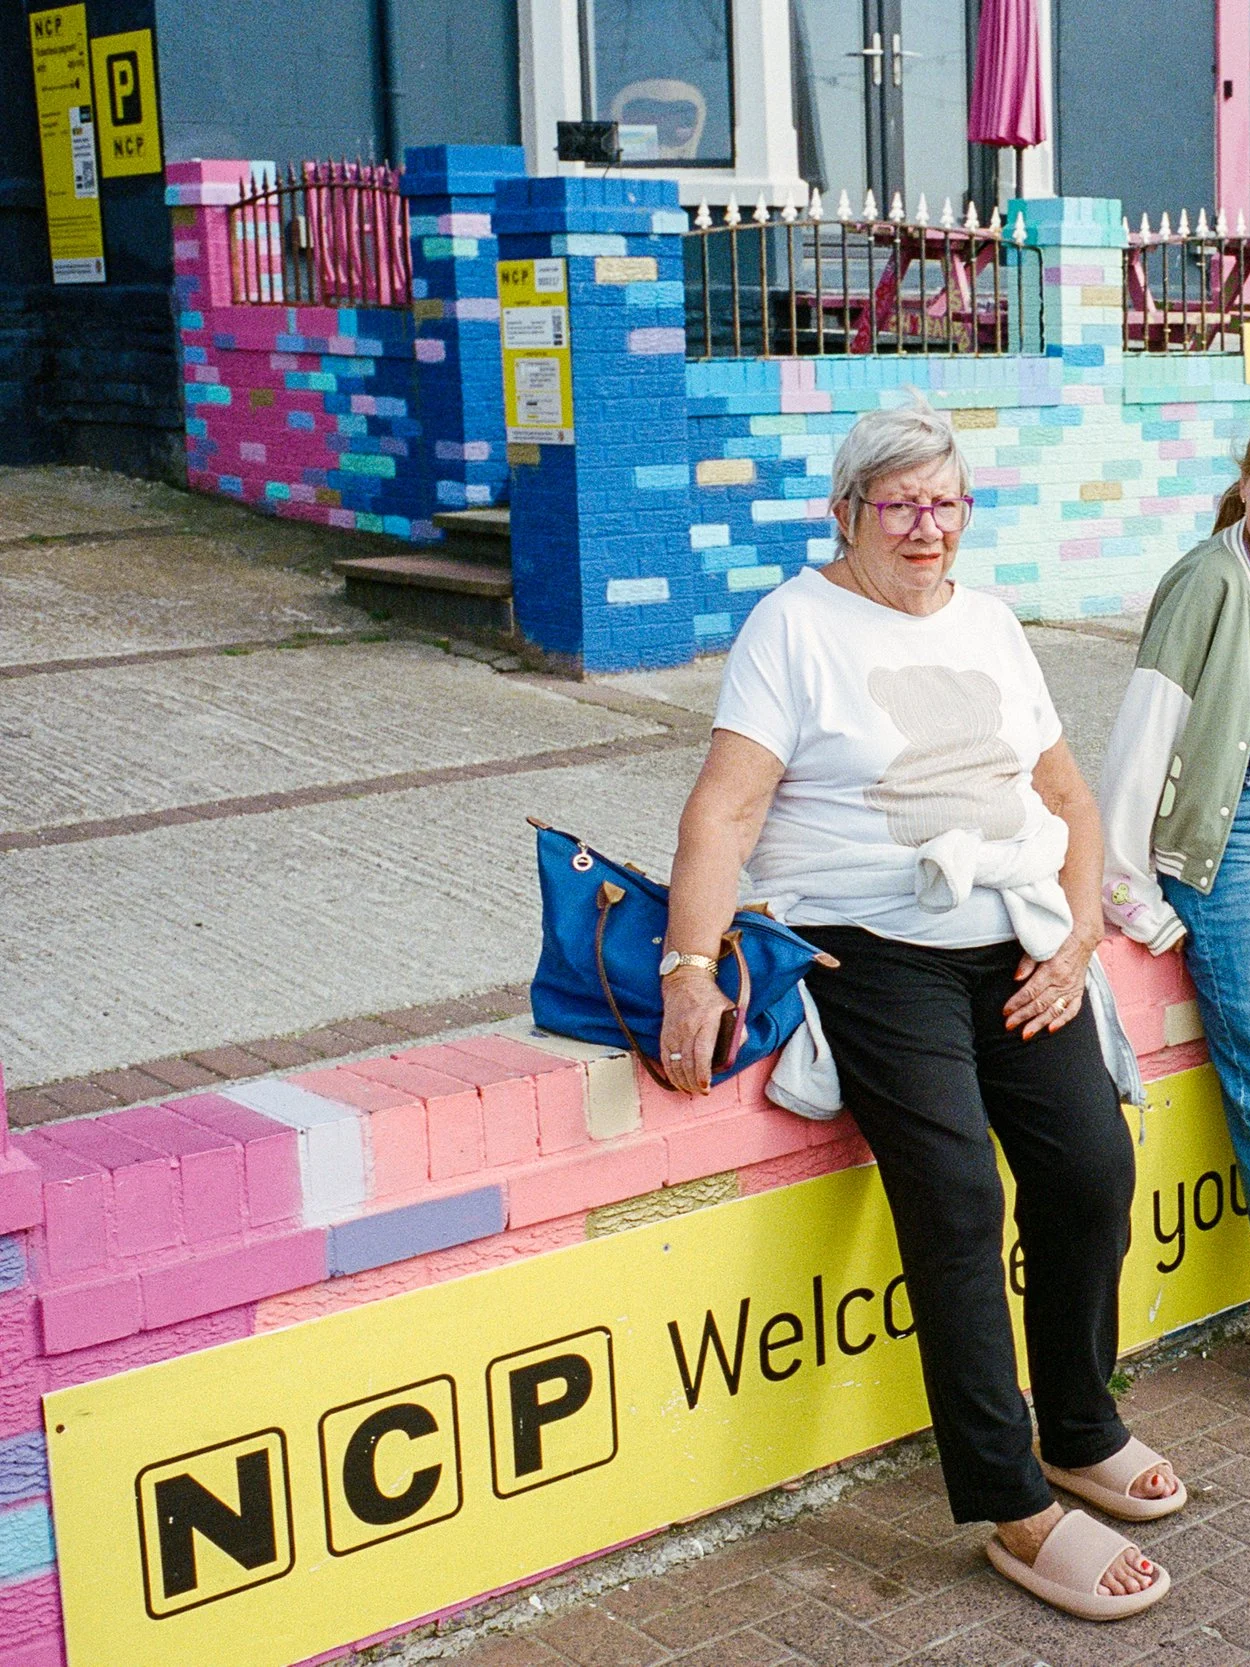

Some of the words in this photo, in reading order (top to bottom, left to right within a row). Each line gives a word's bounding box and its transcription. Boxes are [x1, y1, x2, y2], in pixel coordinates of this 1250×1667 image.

[35, 15, 62, 37] NCP
[112, 59, 134, 120] P
[113, 136, 144, 157] NCP
[502, 270, 528, 285] NCP
[154, 1353, 593, 1599] NCP
[667, 1239, 1026, 1411] Welco
